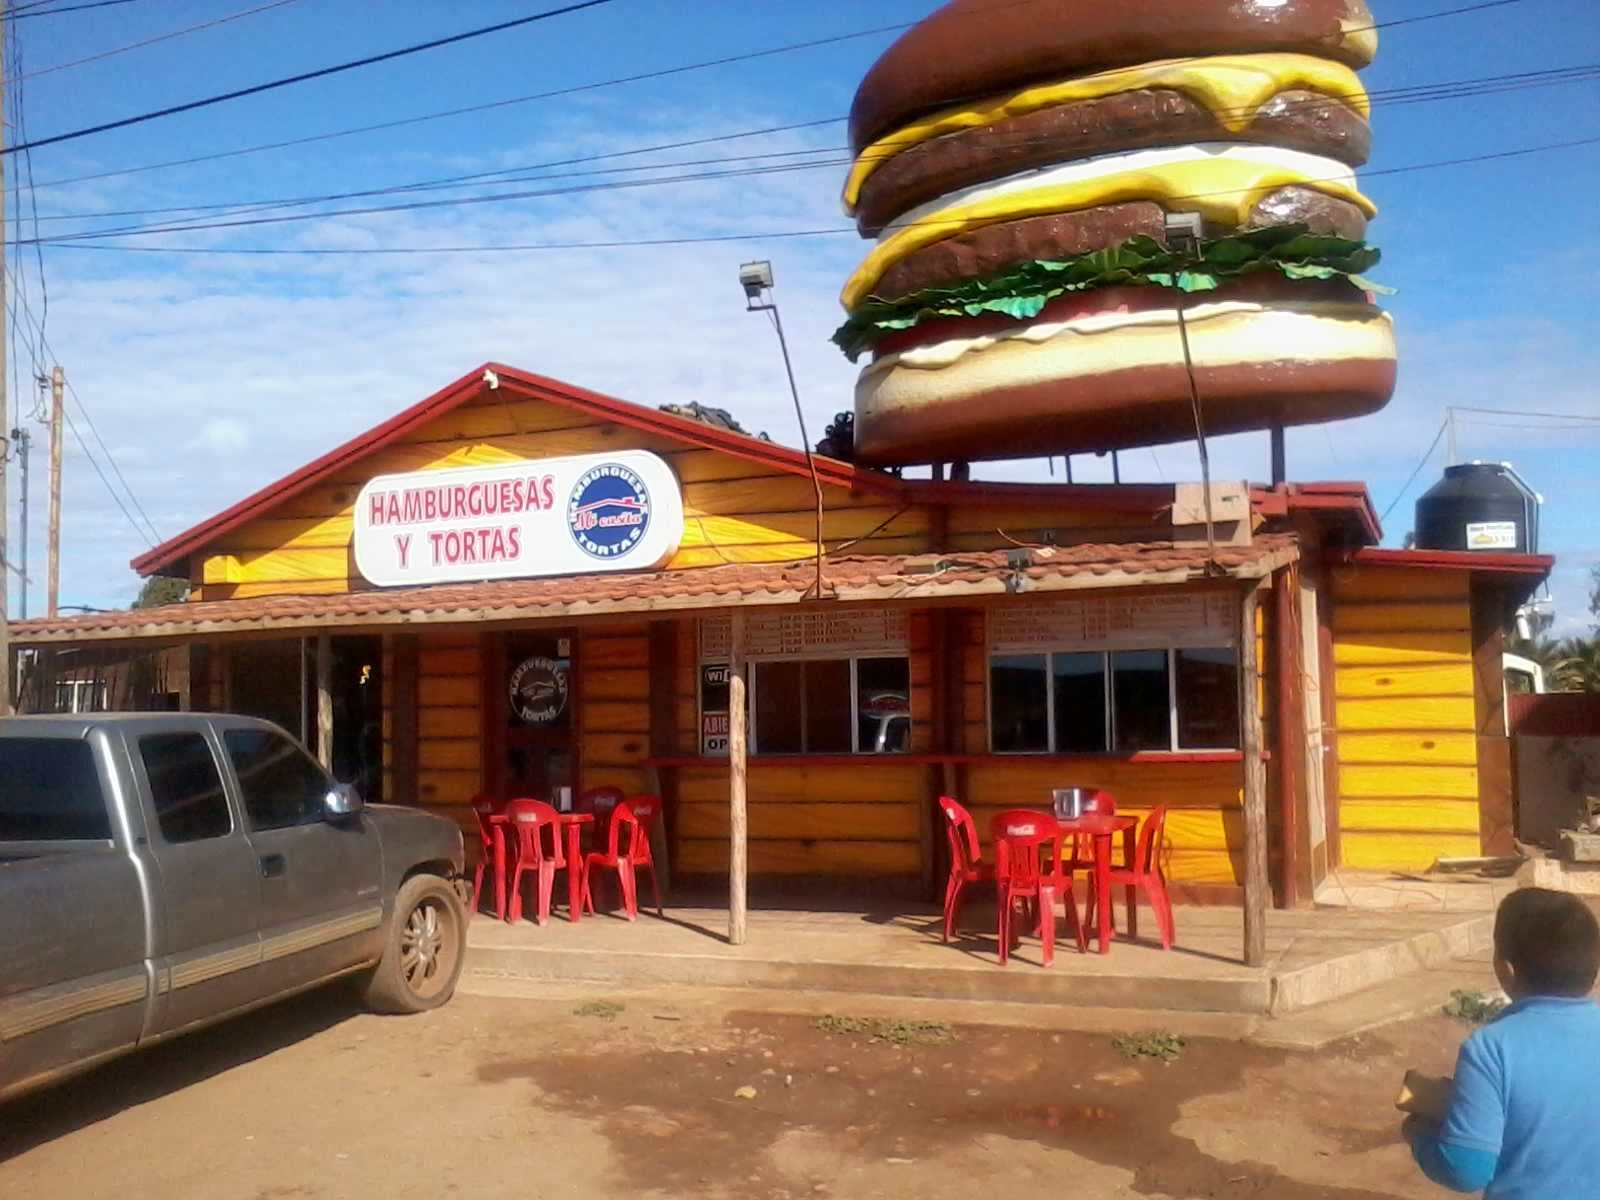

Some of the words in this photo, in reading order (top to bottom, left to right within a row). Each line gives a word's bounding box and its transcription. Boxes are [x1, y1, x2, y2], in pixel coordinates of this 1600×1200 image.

[370, 475, 555, 525] HAMBURGUESAS
[394, 533, 412, 568] Y
[430, 527, 520, 566] TORTAS
[579, 527, 641, 556] TORTAS
